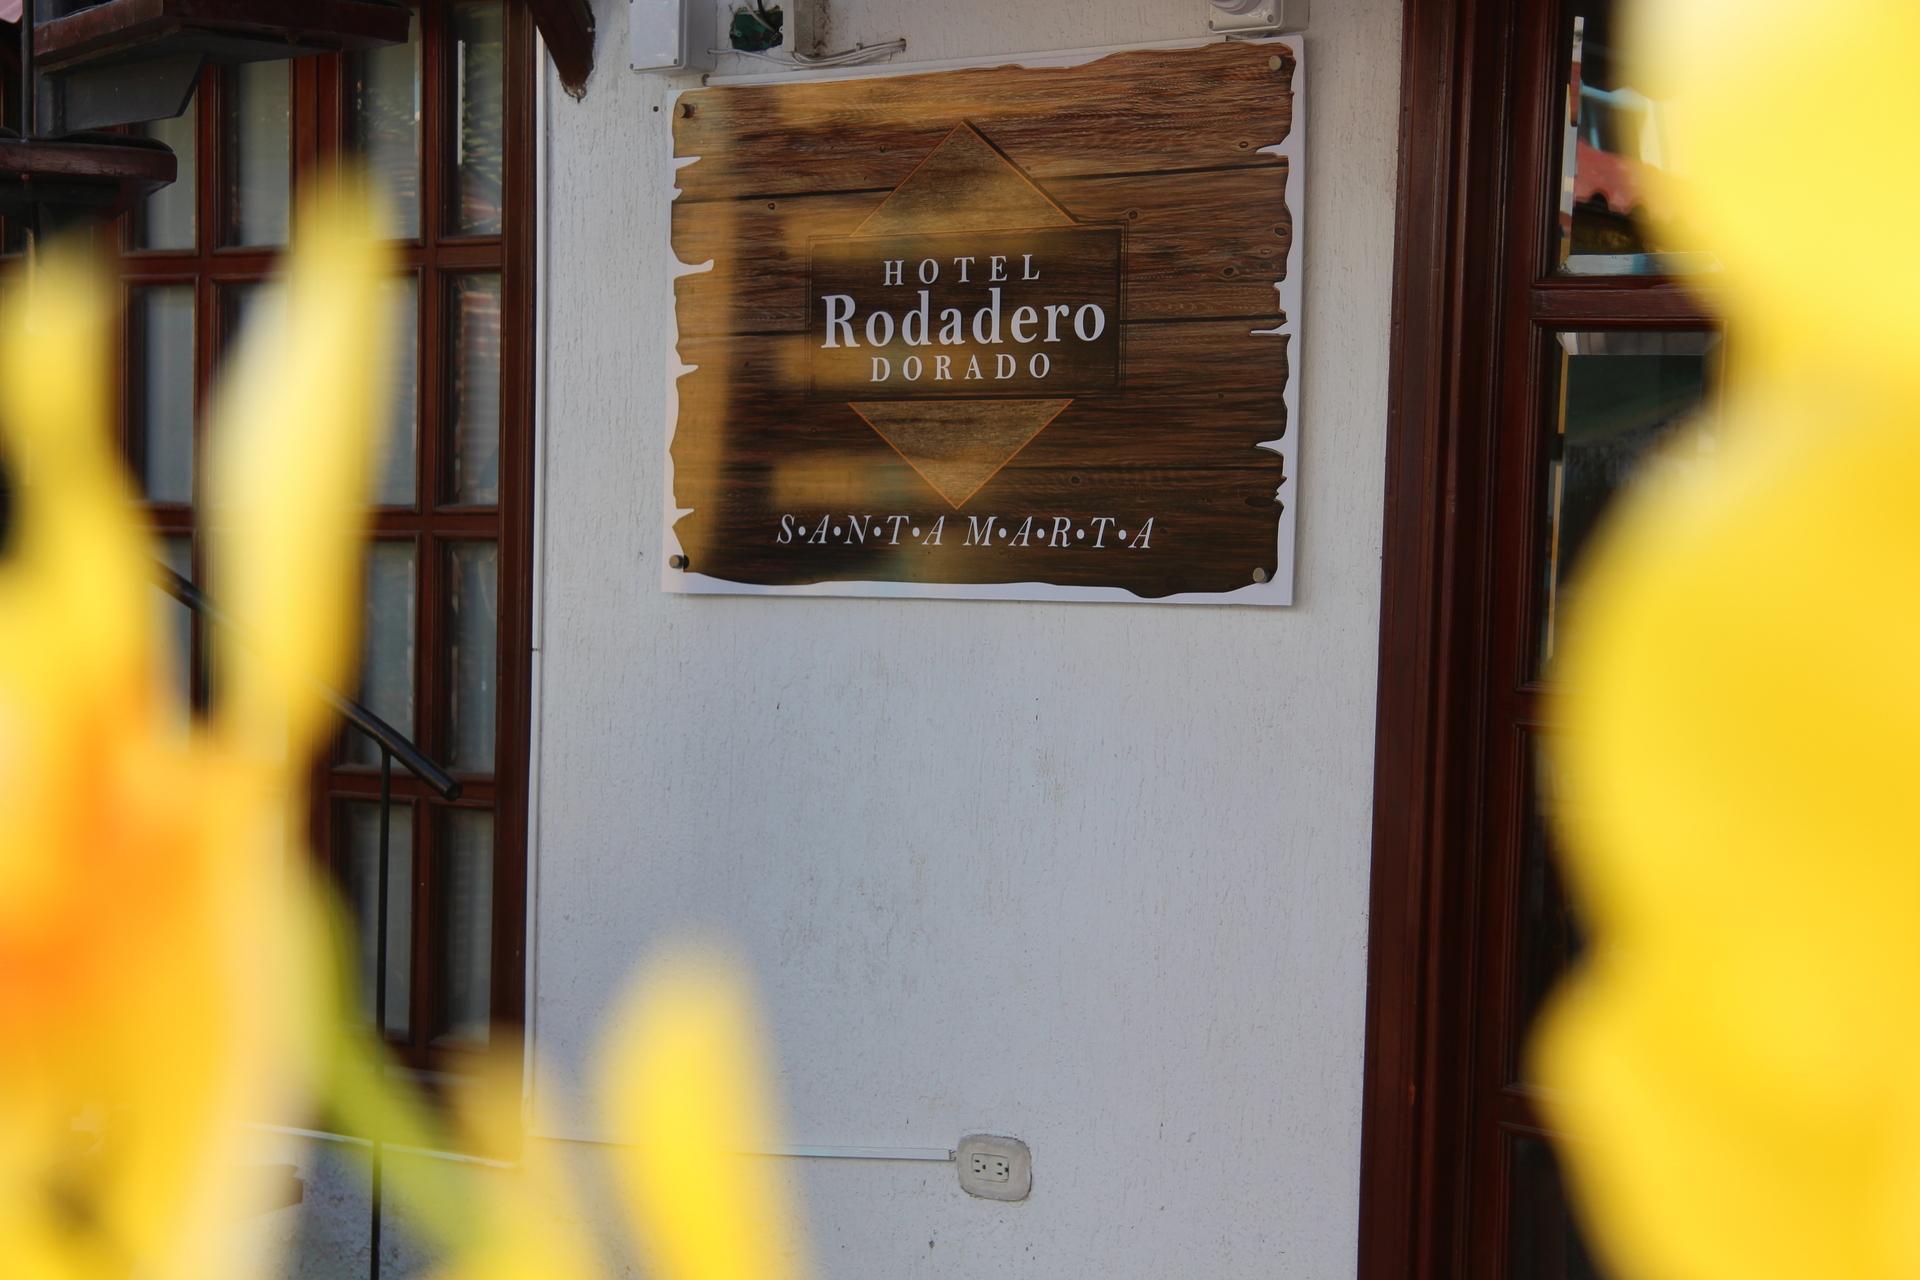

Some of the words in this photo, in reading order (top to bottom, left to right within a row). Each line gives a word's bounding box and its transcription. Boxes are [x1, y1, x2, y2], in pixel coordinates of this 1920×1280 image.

[883, 254, 1040, 285] HOTEL
[821, 288, 1105, 348] Rodadero
[870, 353, 1050, 382] DORADO
